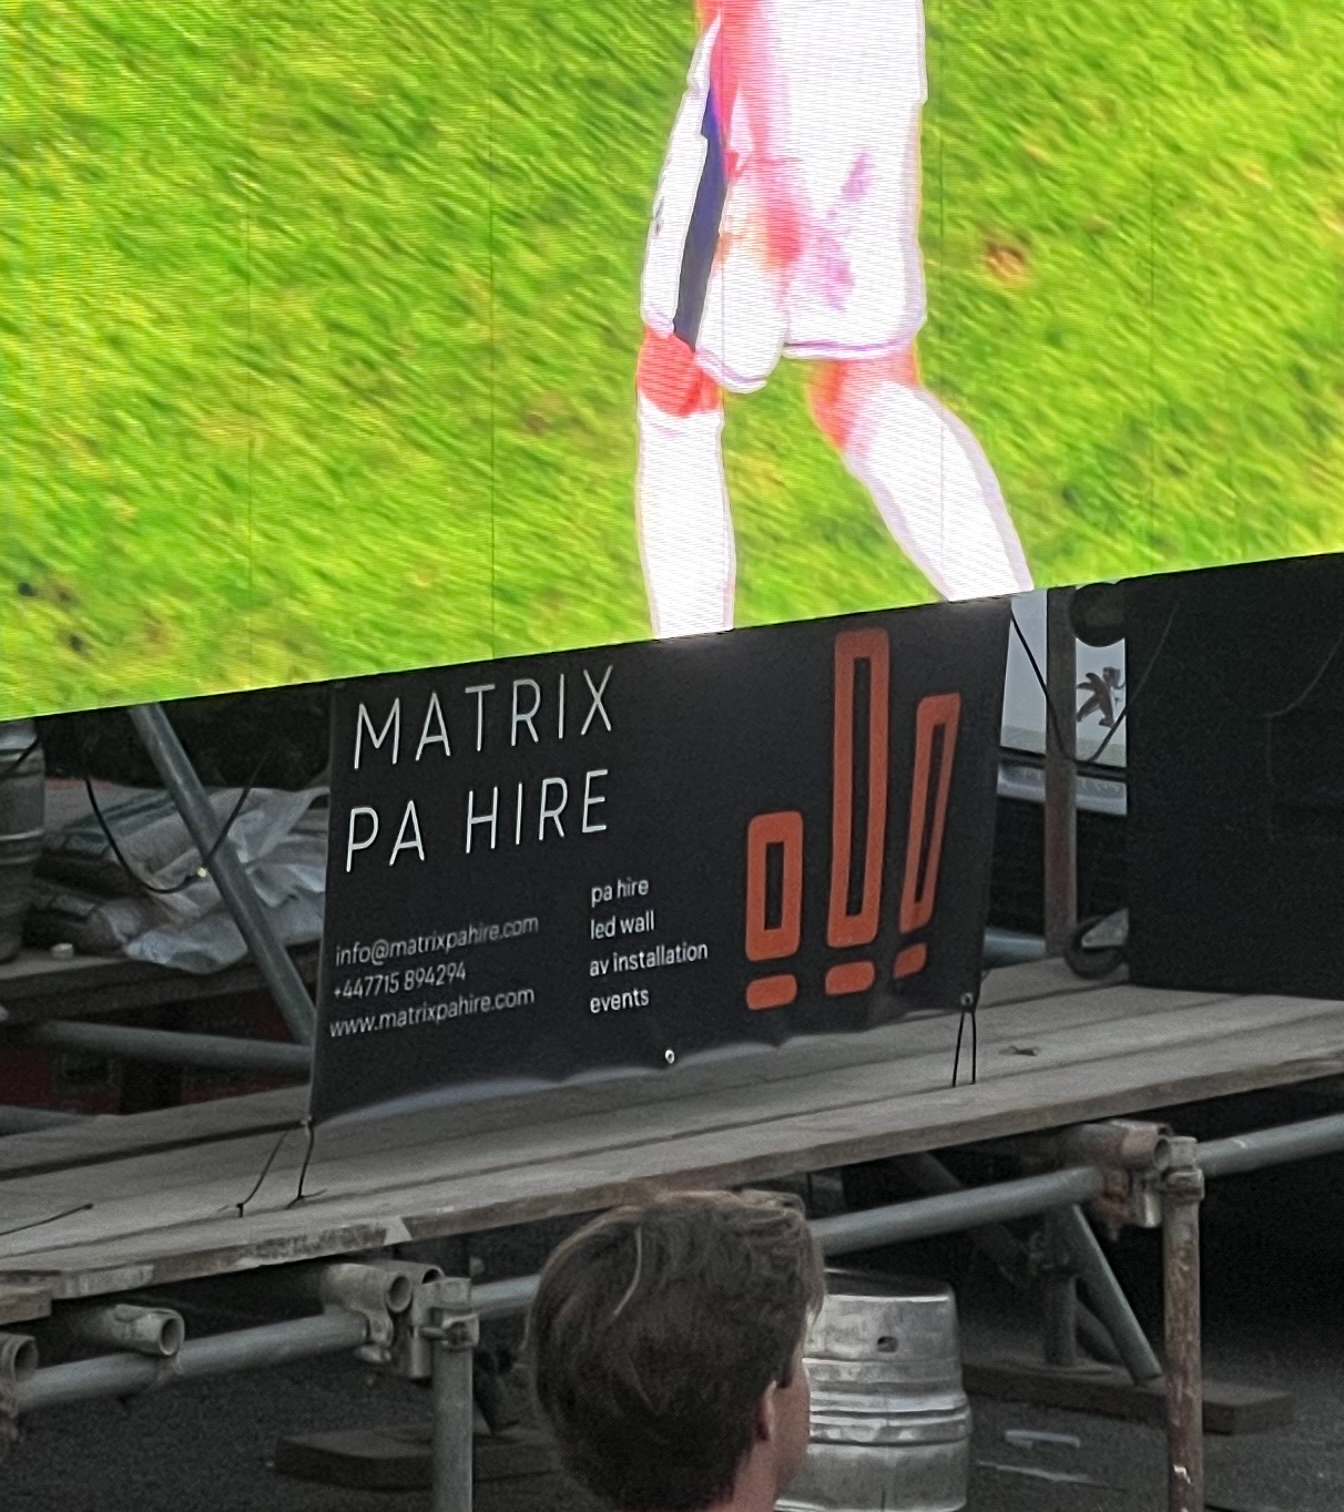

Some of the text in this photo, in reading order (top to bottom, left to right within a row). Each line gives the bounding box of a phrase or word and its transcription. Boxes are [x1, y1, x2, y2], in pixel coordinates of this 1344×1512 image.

[354, 664, 613, 769] MATRIX
[345, 769, 608, 873] PA HIRE
[591, 876, 649, 908] pa hire
[335, 917, 539, 966] info@matrixpahire.com
[590, 909, 655, 939] led wall
[589, 941, 709, 977] av installation
[333, 961, 466, 999] +447715 894294
[330, 988, 535, 1037] www.matrixpahire.com
[590, 989, 650, 1014] events
